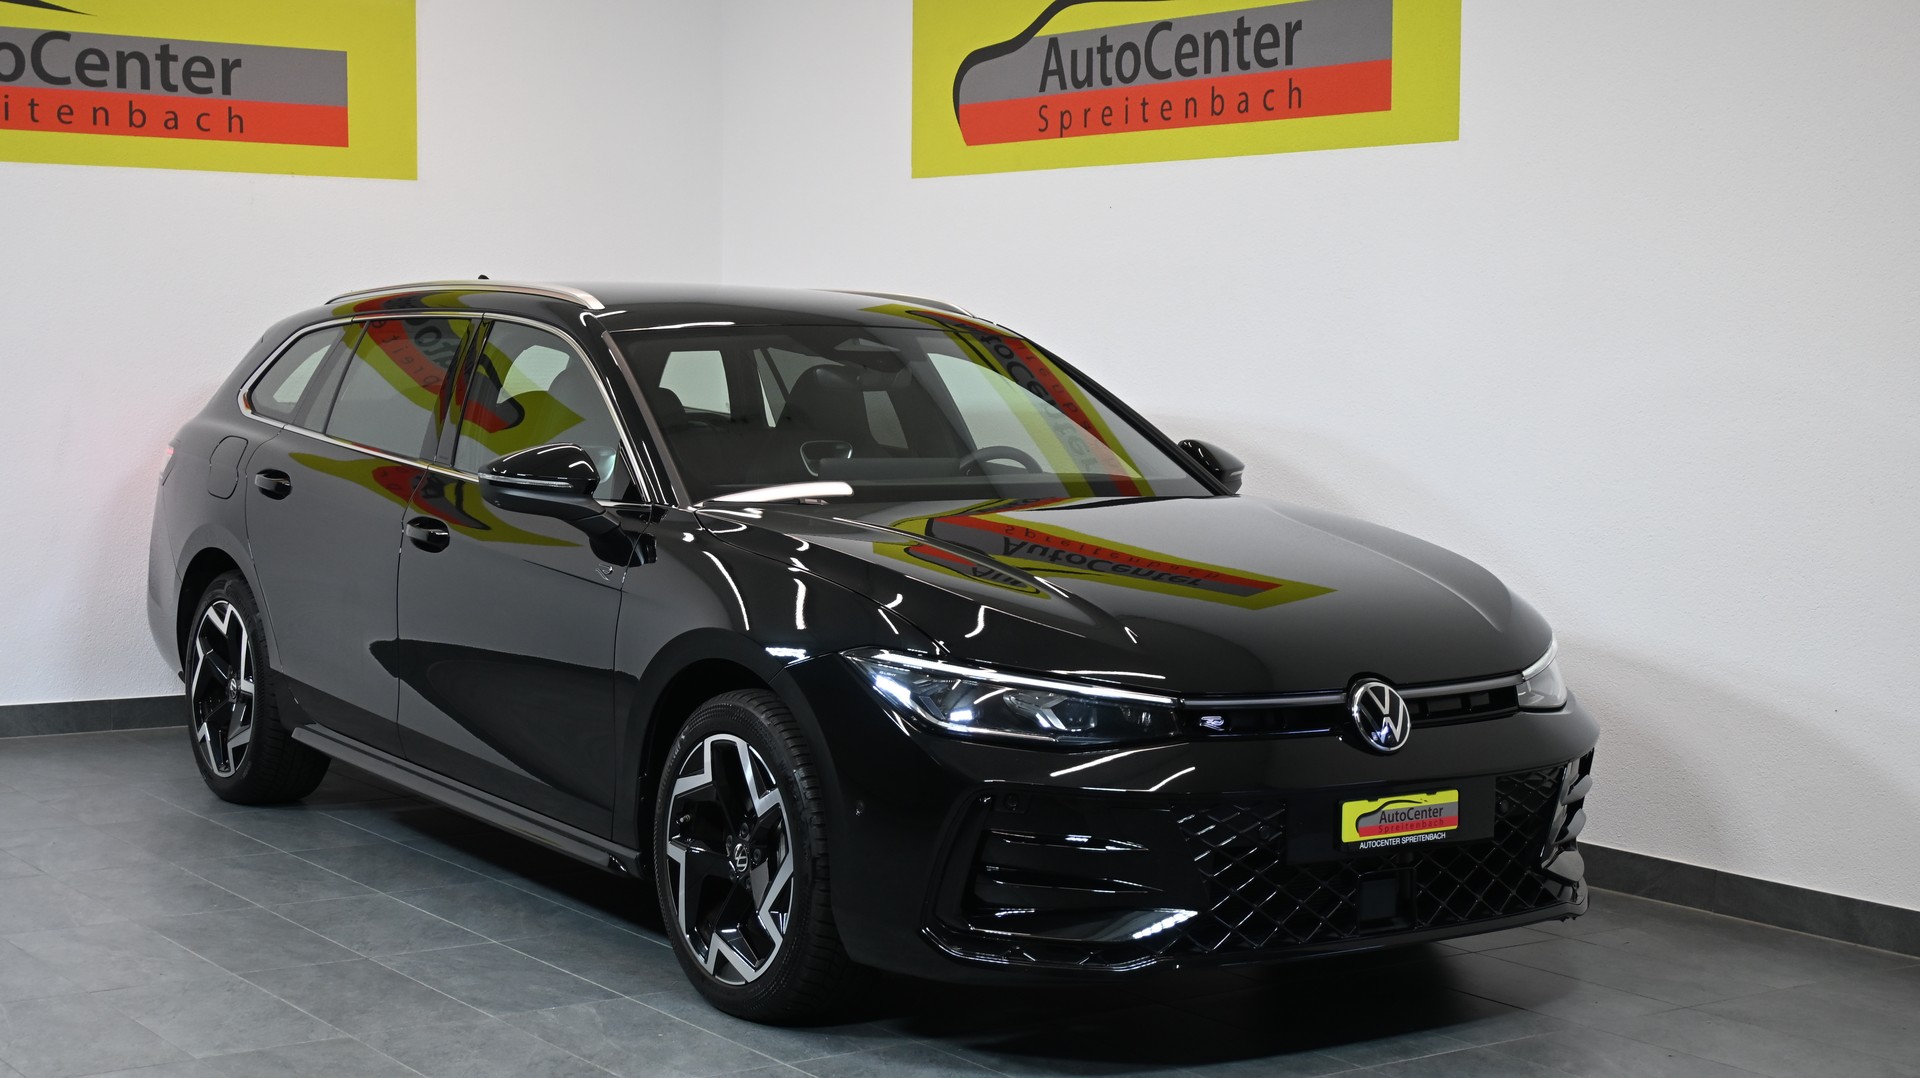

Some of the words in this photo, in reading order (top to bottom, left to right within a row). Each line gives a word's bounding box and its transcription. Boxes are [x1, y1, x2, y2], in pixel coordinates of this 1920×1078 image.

[1038, 16, 1303, 94] AutoCenter
[1038, 78, 1303, 137] Spreitenbach
[1379, 807, 1444, 823] AutoCenter
[1379, 819, 1444, 833] Spreitenbach
[1359, 838, 1401, 849] AUTOCENTER
[1401, 832, 1446, 844] SPREITENBACH
